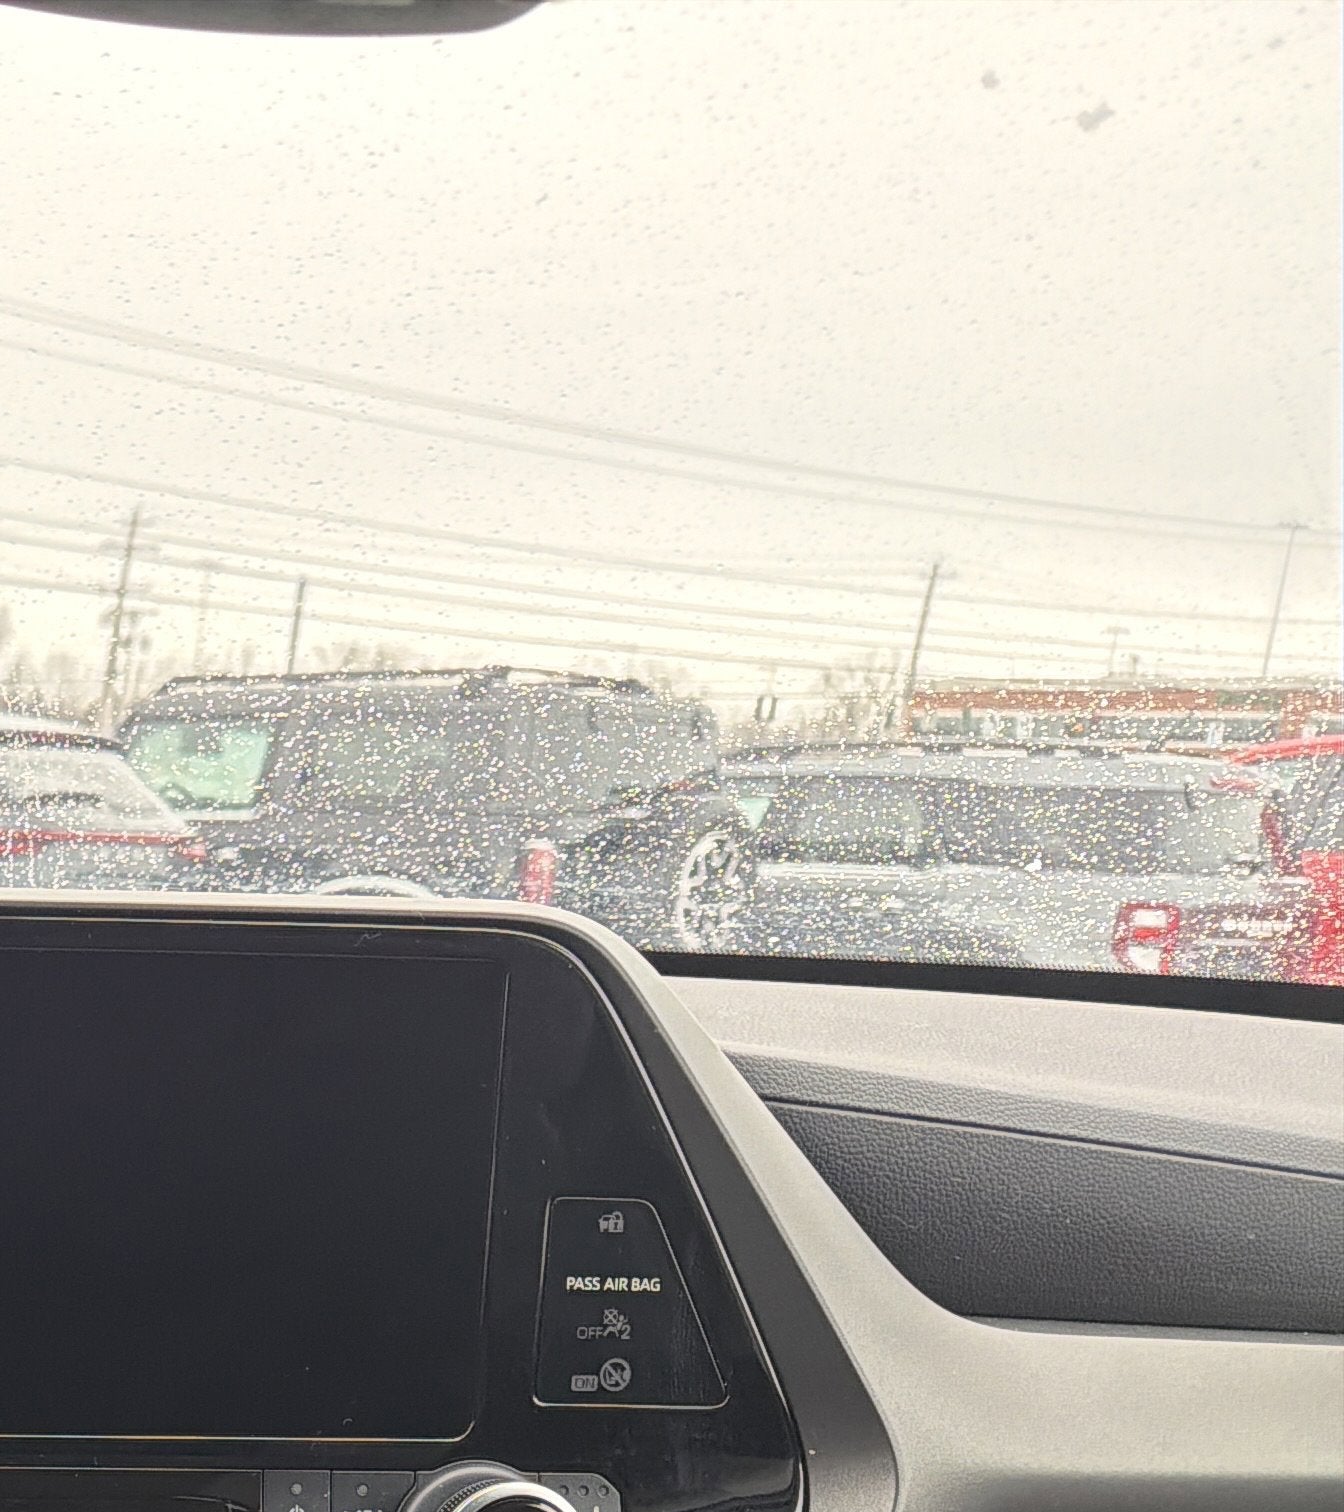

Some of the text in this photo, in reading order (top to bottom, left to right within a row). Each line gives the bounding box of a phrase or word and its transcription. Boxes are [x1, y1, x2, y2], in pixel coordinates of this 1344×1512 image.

[566, 1276, 661, 1292] PASS AIR BAG
[576, 1326, 603, 1340] OFF
[574, 1377, 596, 1389] ON
